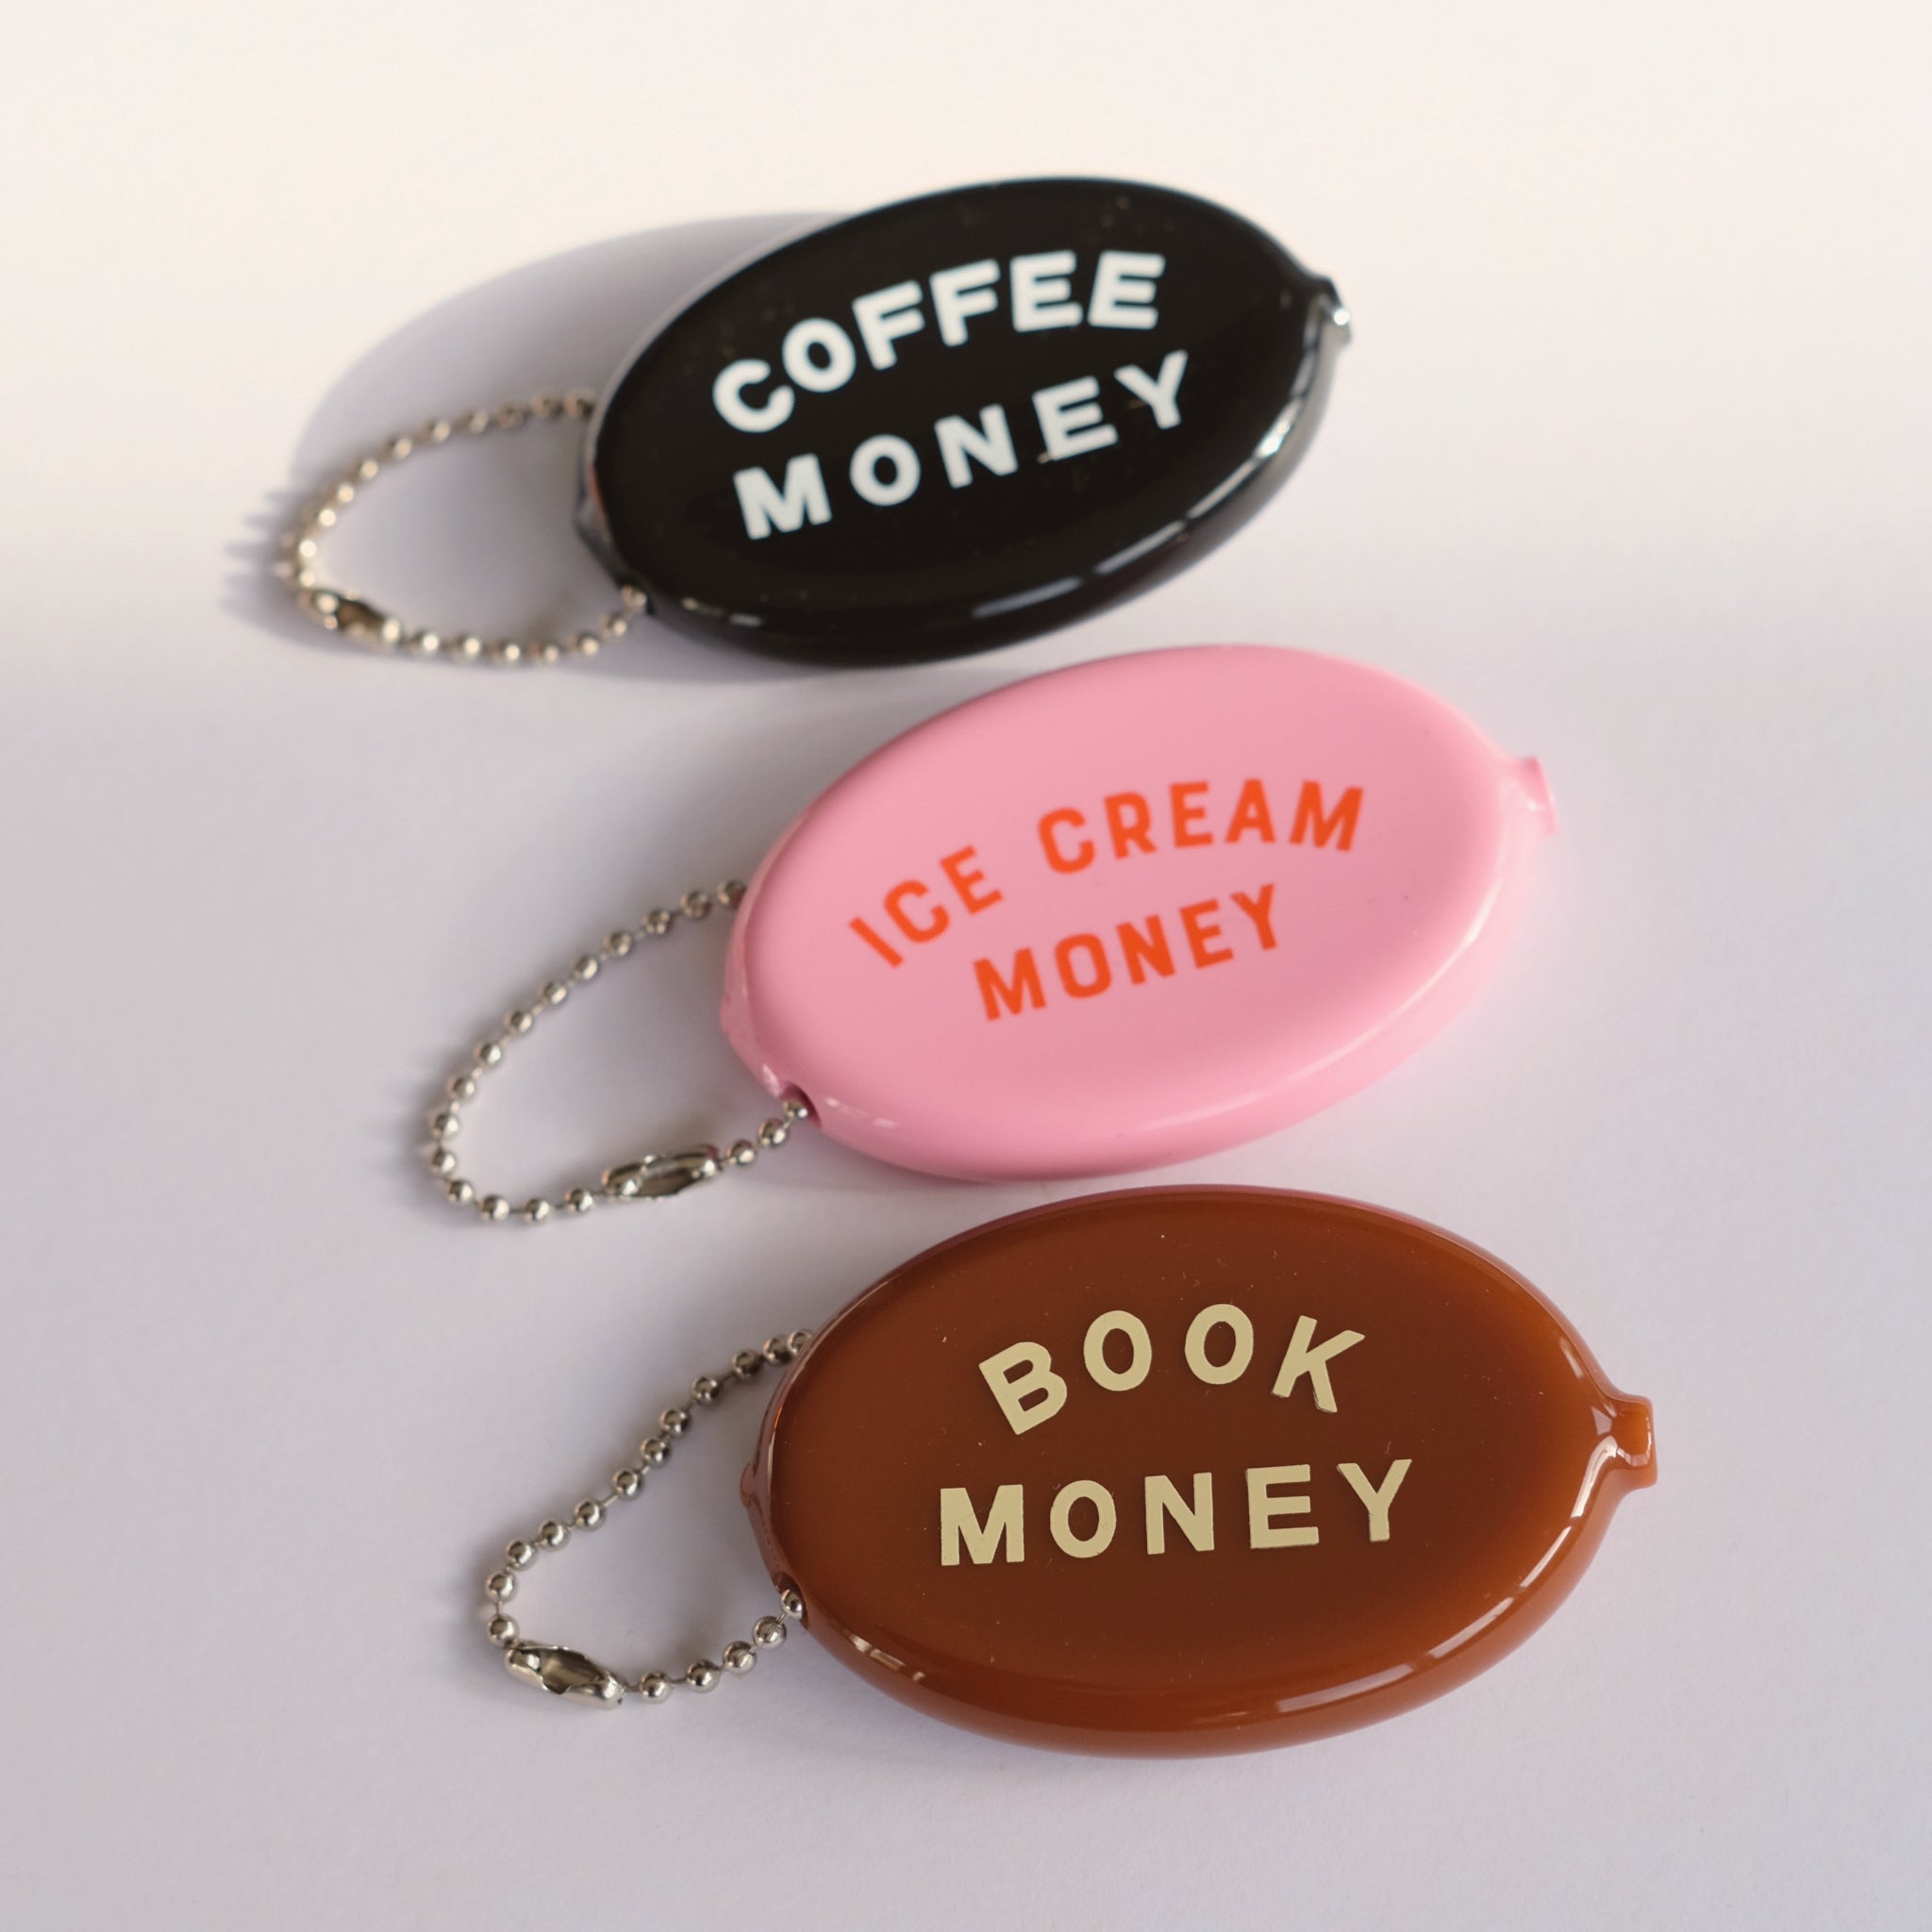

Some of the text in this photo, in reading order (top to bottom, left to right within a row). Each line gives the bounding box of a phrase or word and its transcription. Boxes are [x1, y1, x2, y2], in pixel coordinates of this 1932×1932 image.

[713, 251, 1166, 432] COFFEE
[734, 351, 1189, 540] MONEY
[848, 777, 1366, 969] ICE CREAM
[973, 882, 1279, 1022] MONEY
[978, 1303, 1366, 1436] BOOK
[940, 1458, 1413, 1567] MONEY
